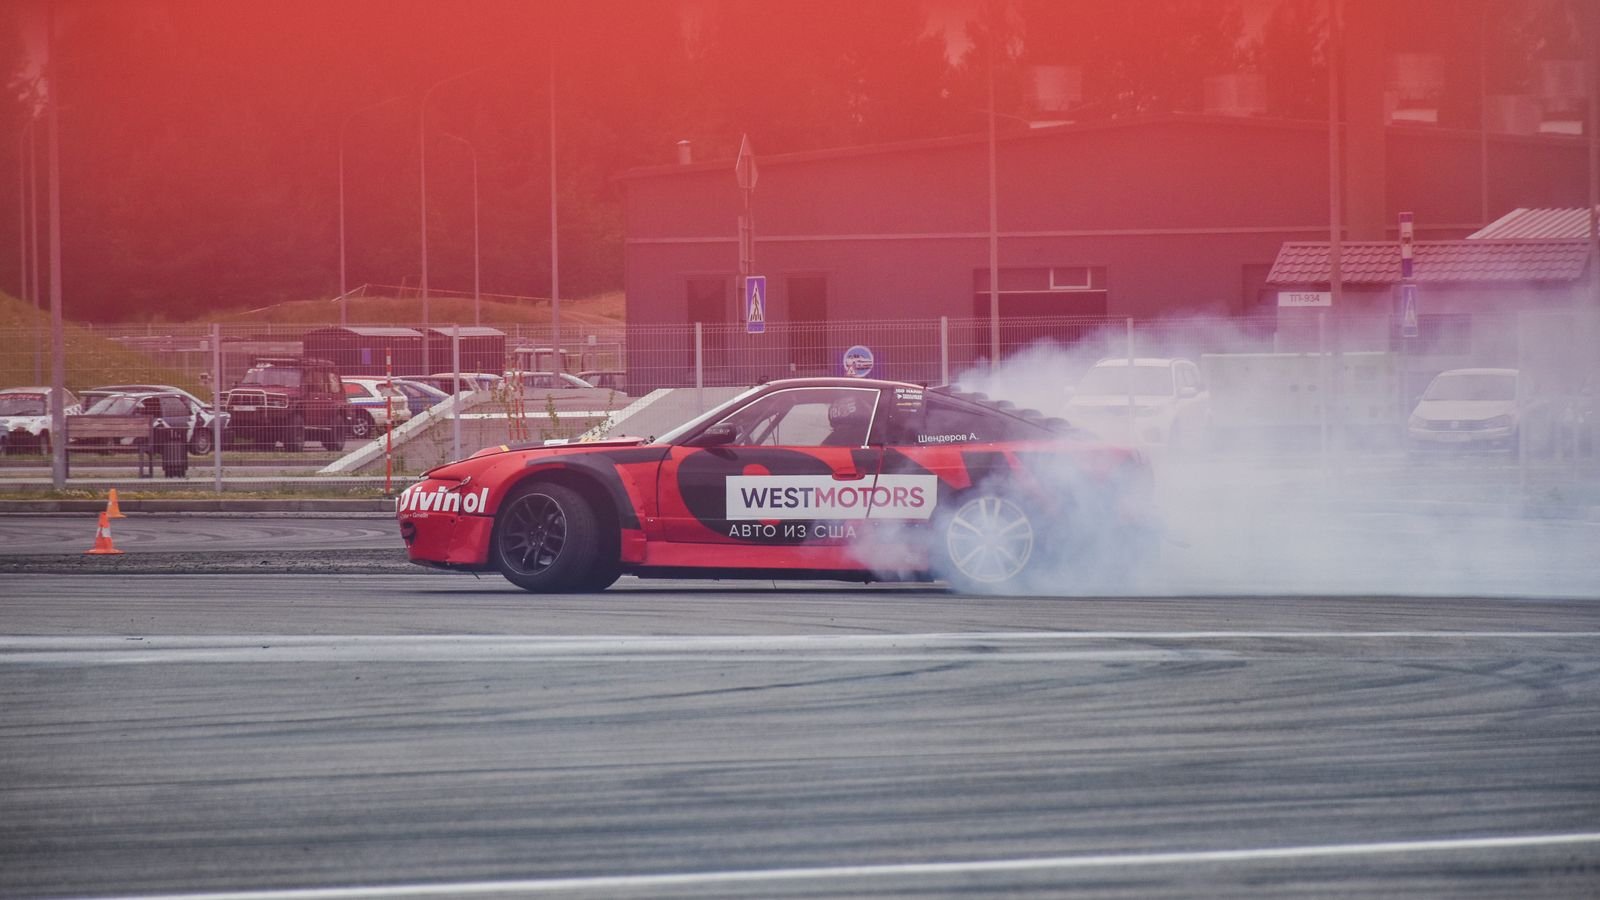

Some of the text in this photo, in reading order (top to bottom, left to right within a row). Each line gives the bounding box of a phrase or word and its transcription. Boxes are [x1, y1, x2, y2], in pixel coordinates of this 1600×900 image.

[918, 434, 967, 443] Шендеров
[400, 486, 489, 513] Divinol
[741, 487, 925, 508] WESTMOTORS
[729, 524, 857, 538] АВТО ИЗ США
